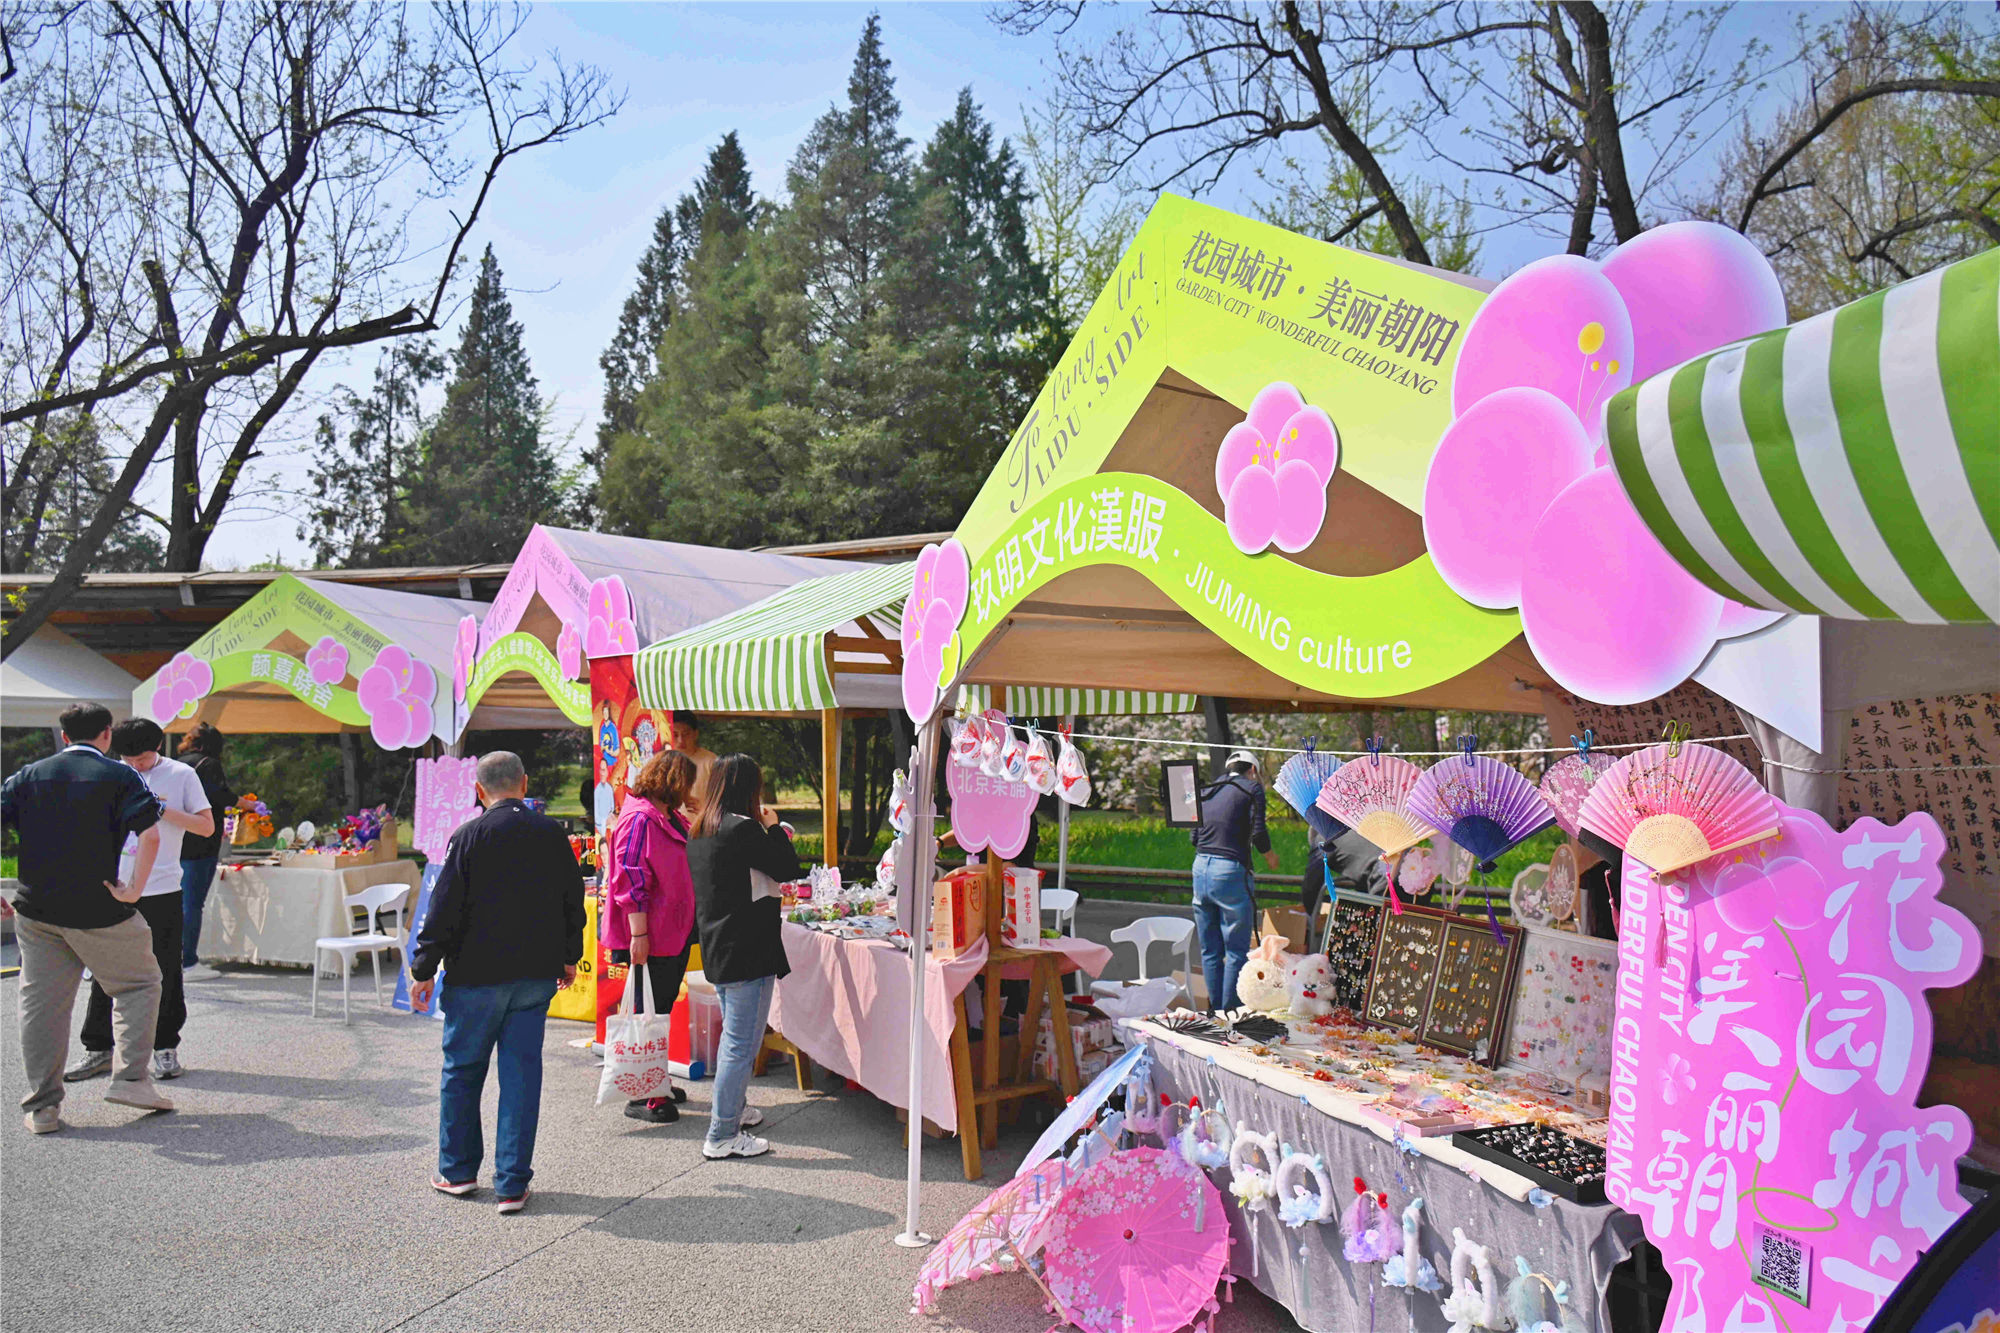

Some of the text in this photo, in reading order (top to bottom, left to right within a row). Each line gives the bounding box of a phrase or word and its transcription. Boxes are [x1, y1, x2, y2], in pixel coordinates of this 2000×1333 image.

[1007, 409, 1040, 514] To
[1104, 250, 1146, 334] Art
[1035, 305, 1150, 489] LIDU SIDE
[1176, 277, 1439, 395] GARDEN CITY WONDERFUL CHAOYANG
[971, 486, 1167, 624] 玖明文化漢服
[1185, 560, 1414, 674] JIUMING culture
[1610, 854, 1650, 1206] NDERFUL CHAOYANG
[1659, 880, 1690, 1037] DEN CITY
